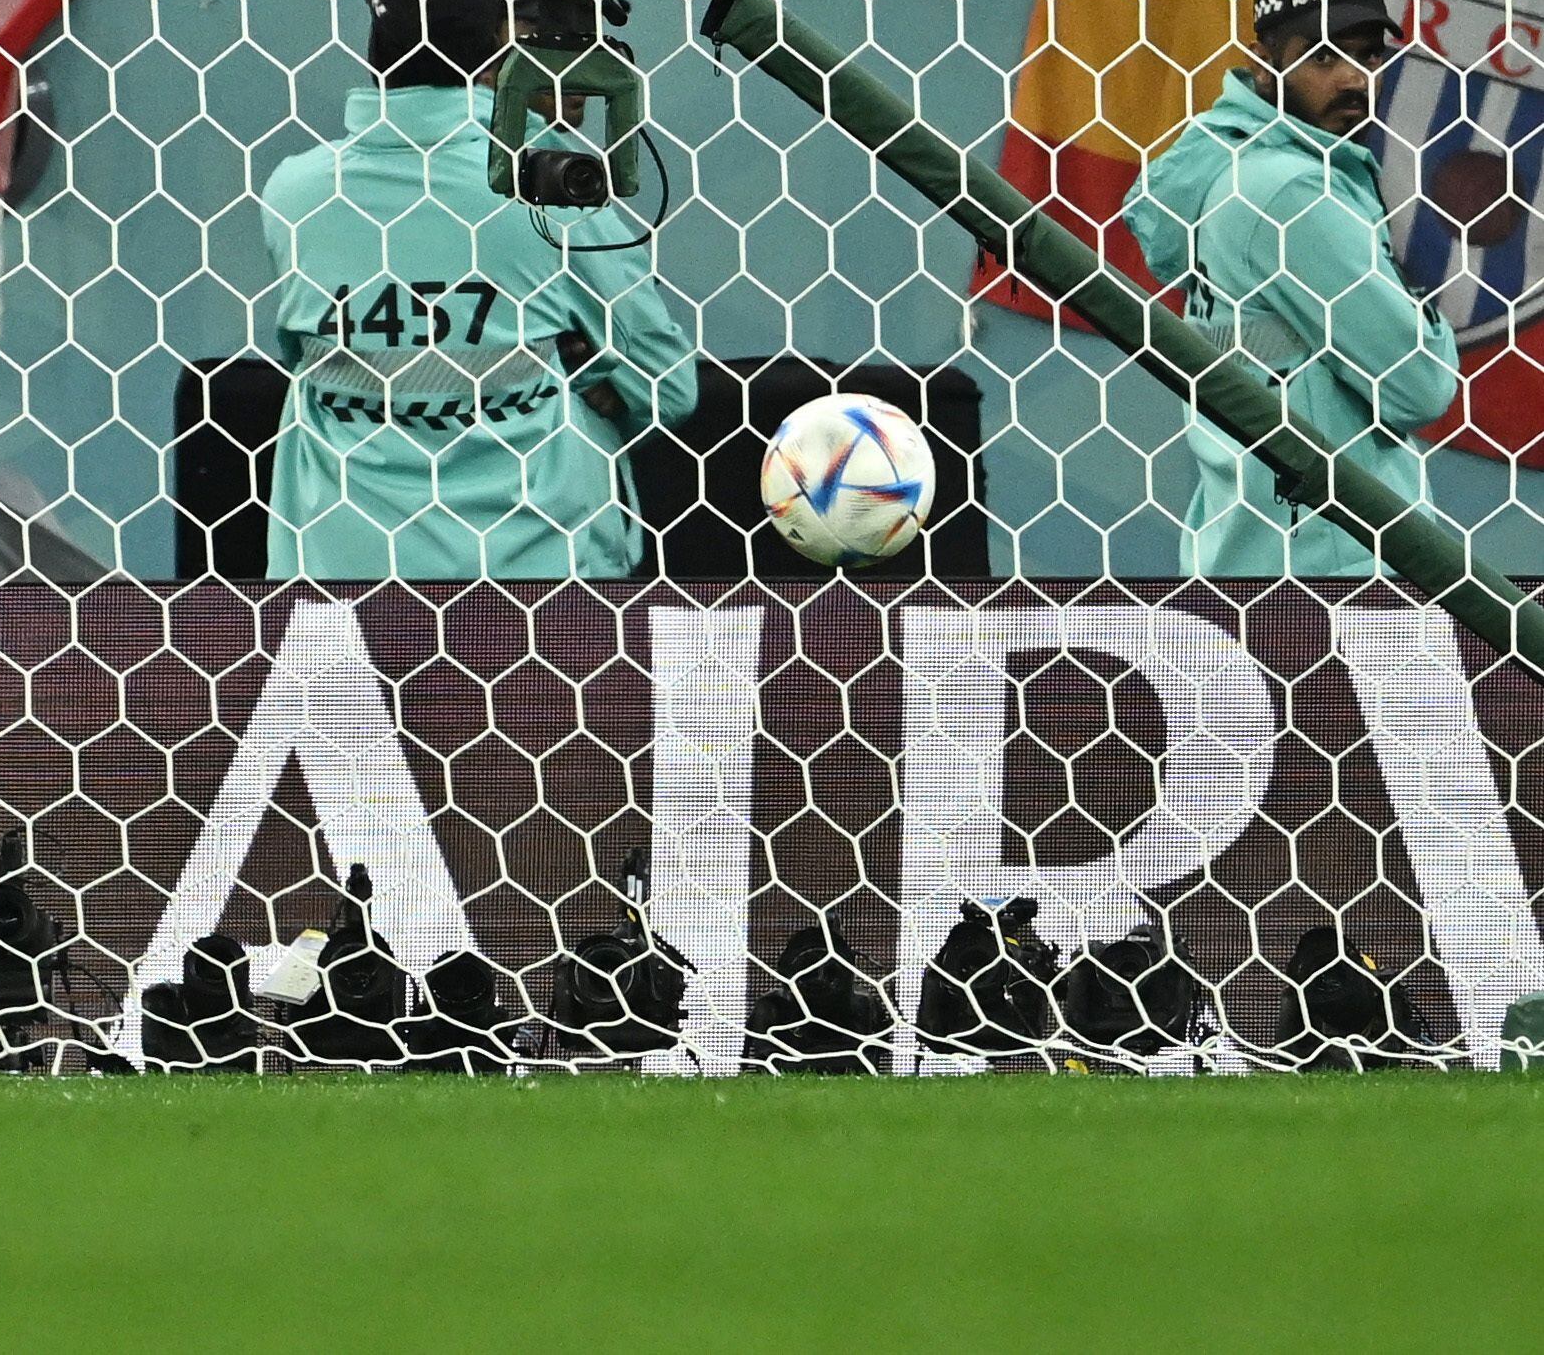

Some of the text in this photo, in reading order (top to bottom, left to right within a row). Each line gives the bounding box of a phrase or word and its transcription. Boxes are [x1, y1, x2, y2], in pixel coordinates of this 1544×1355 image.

[1487, 20, 1541, 78] C
[317, 280, 499, 348] 4457
[103, 598, 1544, 1078] AIR
